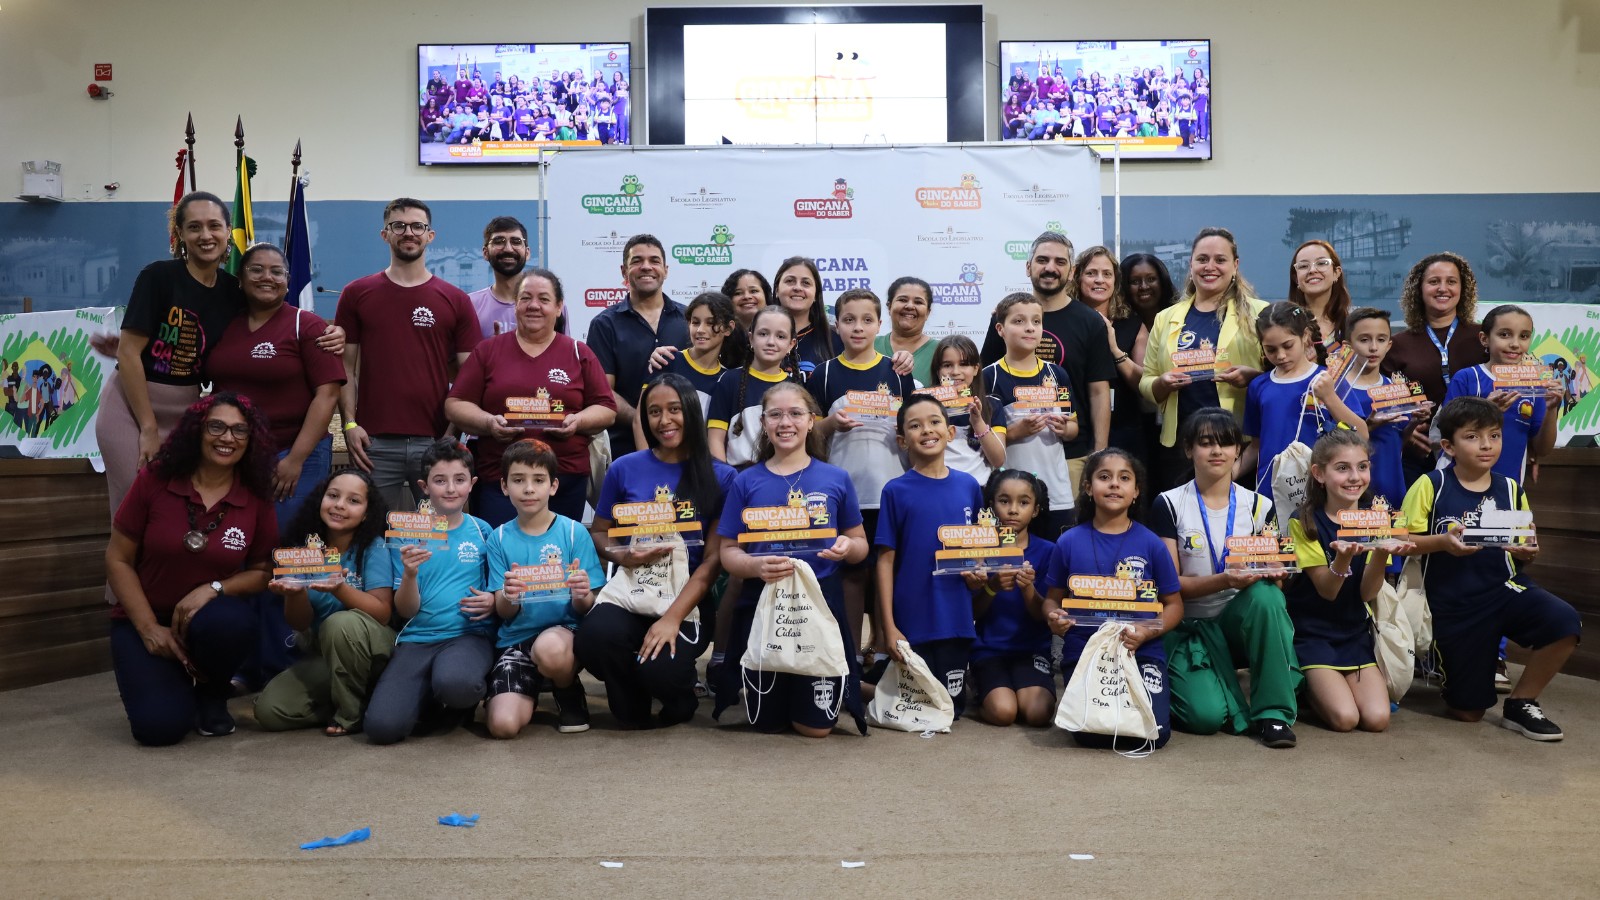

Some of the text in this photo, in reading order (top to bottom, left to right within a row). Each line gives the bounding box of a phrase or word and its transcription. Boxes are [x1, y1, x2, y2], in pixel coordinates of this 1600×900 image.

[918, 190, 978, 200] GINCANA
[584, 196, 640, 206] GINCANA
[796, 201, 849, 210] GINCANA
[674, 247, 729, 256] GINCANA
[816, 258, 868, 272] CANA
[822, 278, 871, 291] ABER
[932, 286, 978, 296] NCANA
[76, 310, 88, 320] EM
[1586, 310, 1600, 320] EM
[960, 388, 971, 396] 25
[1370, 383, 1408, 396] GINCANA
[848, 392, 888, 403] GINCANA
[615, 502, 672, 516] GINCANA
[679, 508, 694, 518] 25
[390, 514, 430, 523] GINCANA
[745, 508, 806, 521] GINCANA
[1341, 512, 1387, 520] GINCANA
[632, 525, 677, 534] CAMPEÃO
[942, 527, 996, 538] GINCANA
[999, 527, 1012, 536] 20
[764, 531, 811, 540] CAMPEÃO
[1002, 534, 1016, 544] 25
[1229, 538, 1276, 546] GINCANA
[1283, 543, 1294, 552] 25
[277, 549, 321, 560] GINCANA
[328, 554, 338, 563] 25
[1072, 577, 1133, 590] GINCANA
[1140, 588, 1156, 598] 25
[1089, 601, 1136, 610] CAMPEÃO
